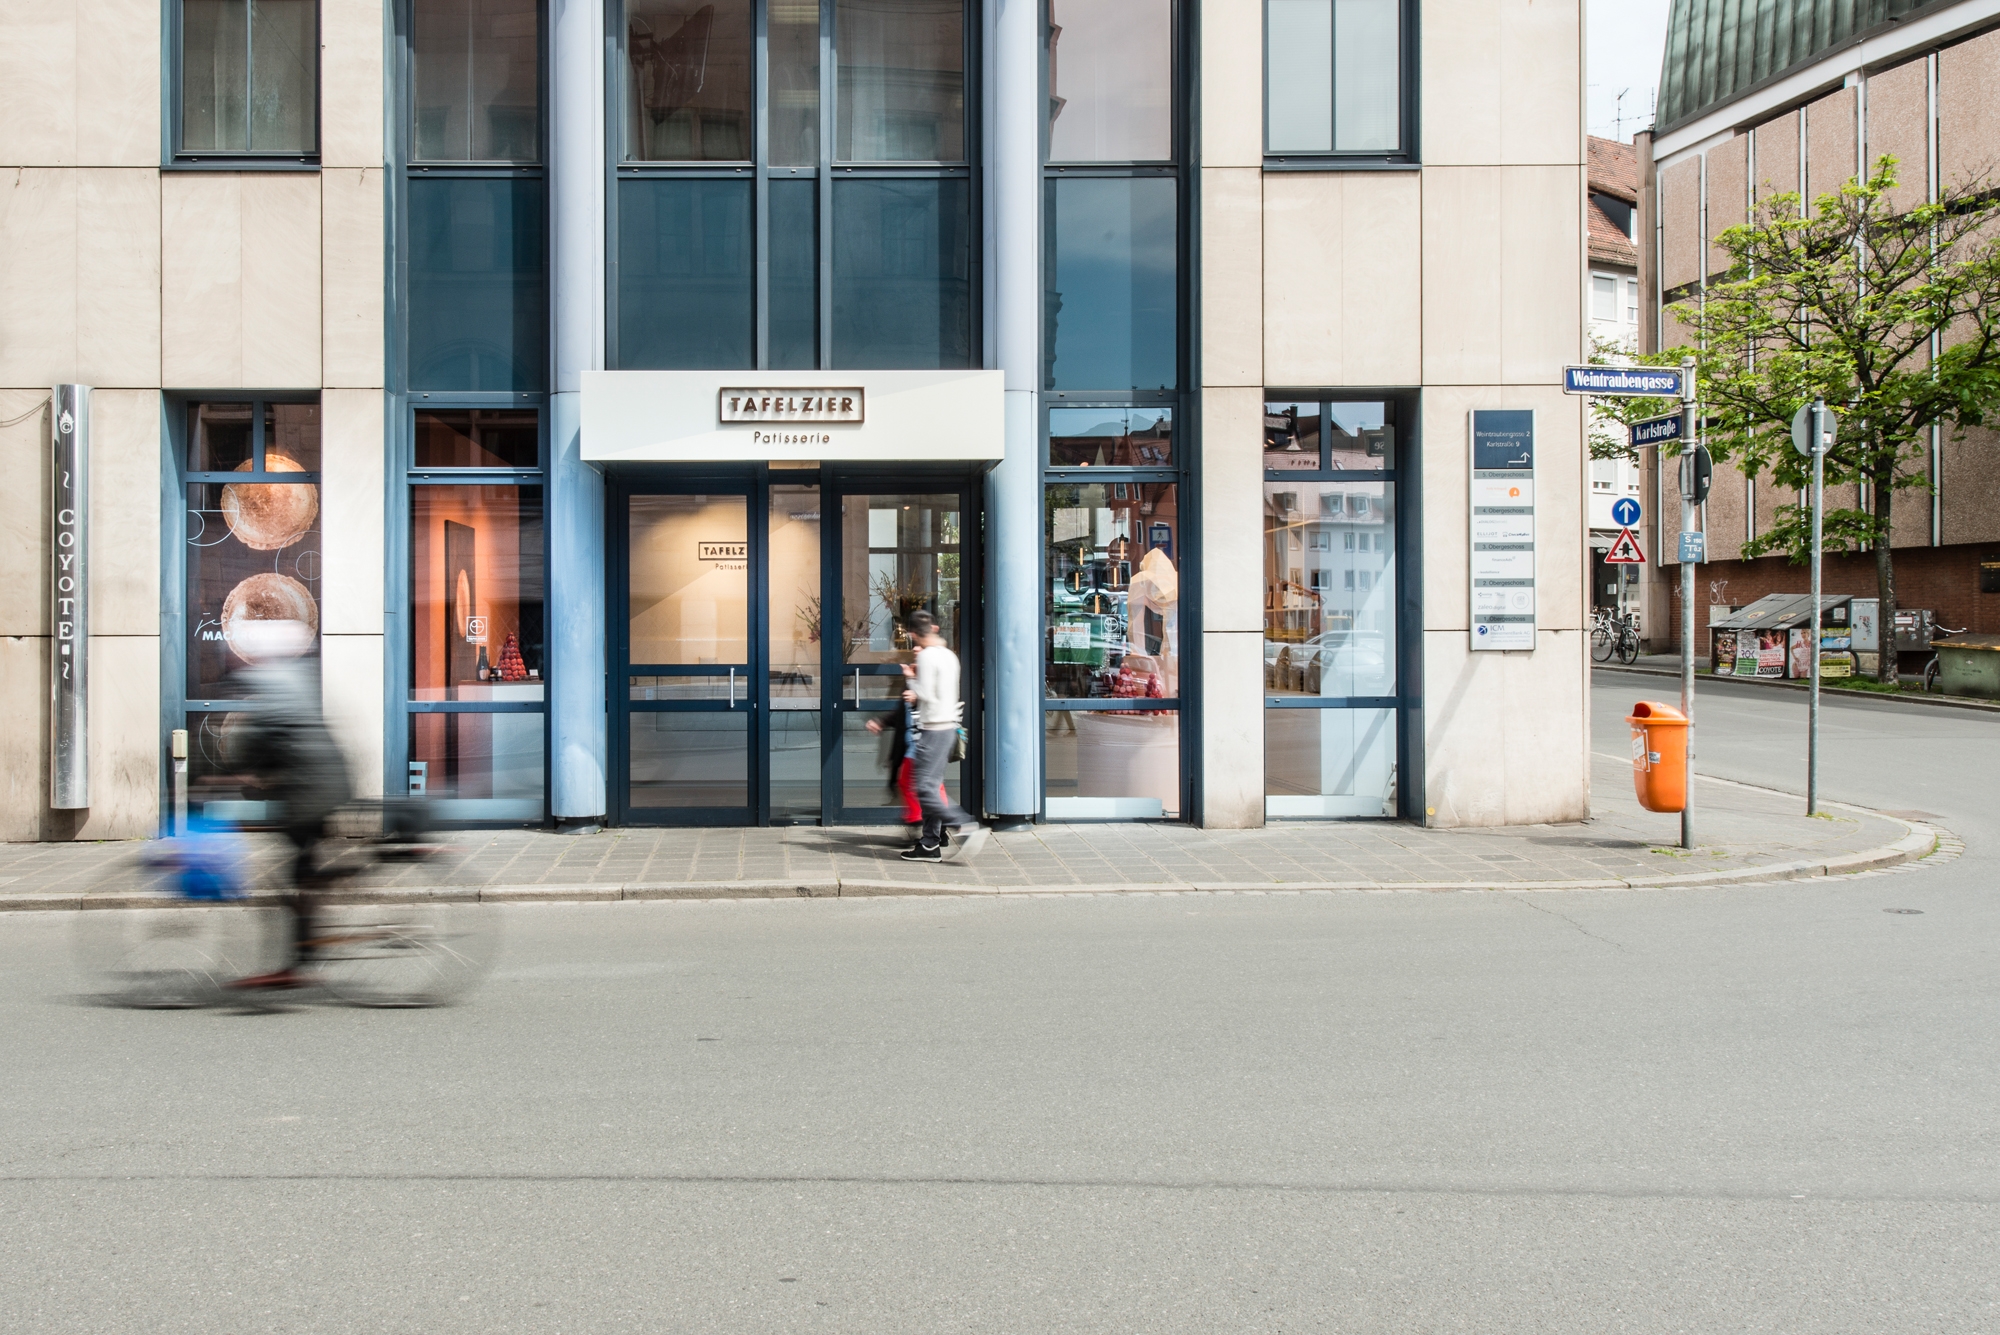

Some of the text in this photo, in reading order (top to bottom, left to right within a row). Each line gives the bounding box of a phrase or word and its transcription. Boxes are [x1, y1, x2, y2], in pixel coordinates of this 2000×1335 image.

[1572, 370, 1674, 391] Weintraubengasse
[731, 397, 853, 412] TAFELZIER
[754, 431, 830, 443] Patisserie
[1636, 419, 1676, 440] Karlstraße
[58, 509, 74, 640] COYOTE
